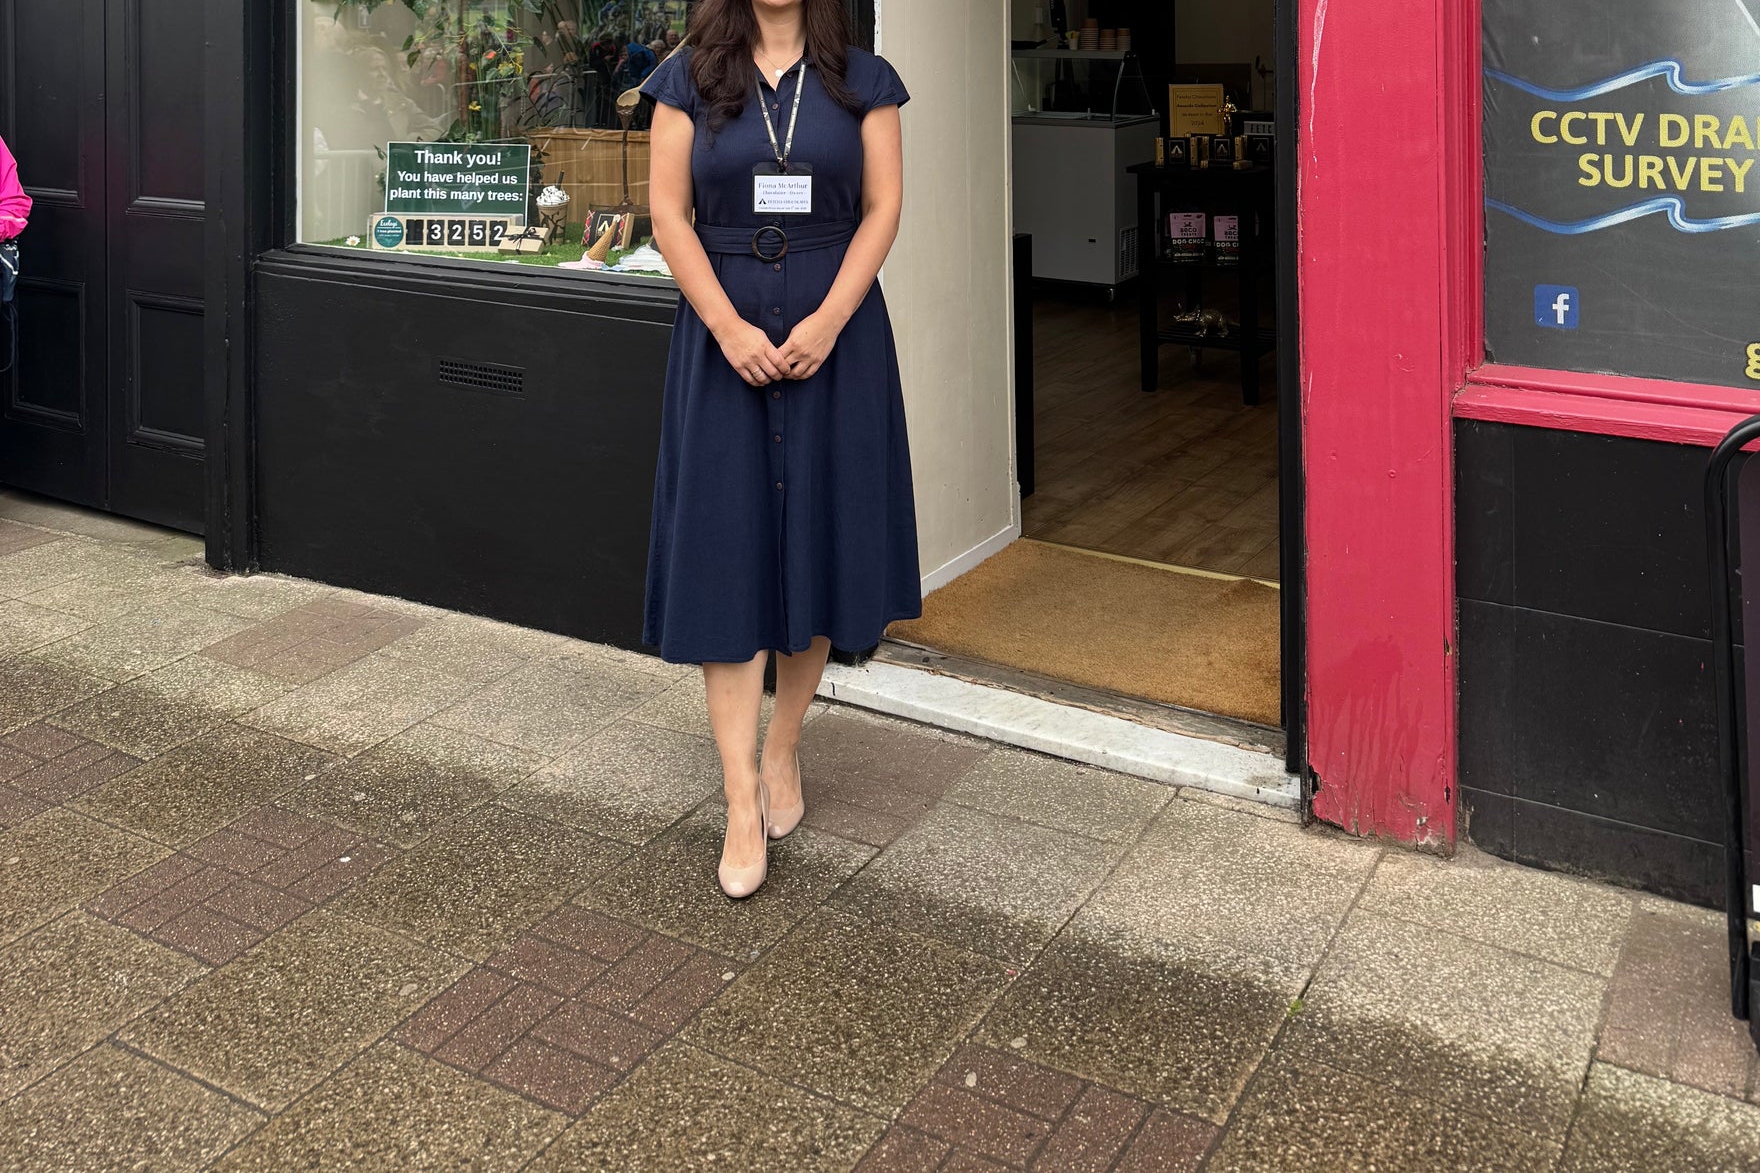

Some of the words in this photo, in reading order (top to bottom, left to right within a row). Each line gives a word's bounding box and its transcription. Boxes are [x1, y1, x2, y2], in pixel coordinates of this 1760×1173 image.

[1530, 110, 1645, 147] CCTV
[1659, 113, 1760, 150] DRA
[413, 149, 463, 165] Thank
[466, 151, 501, 168] you!
[397, 170, 421, 182] You
[424, 170, 454, 183] have
[456, 171, 499, 186] helped
[502, 175, 518, 185] us
[1577, 152, 1755, 193] SURVEY
[389, 187, 422, 201] plant
[424, 187, 448, 200] this
[450, 190, 485, 203] many
[487, 190, 524, 202] trees:
